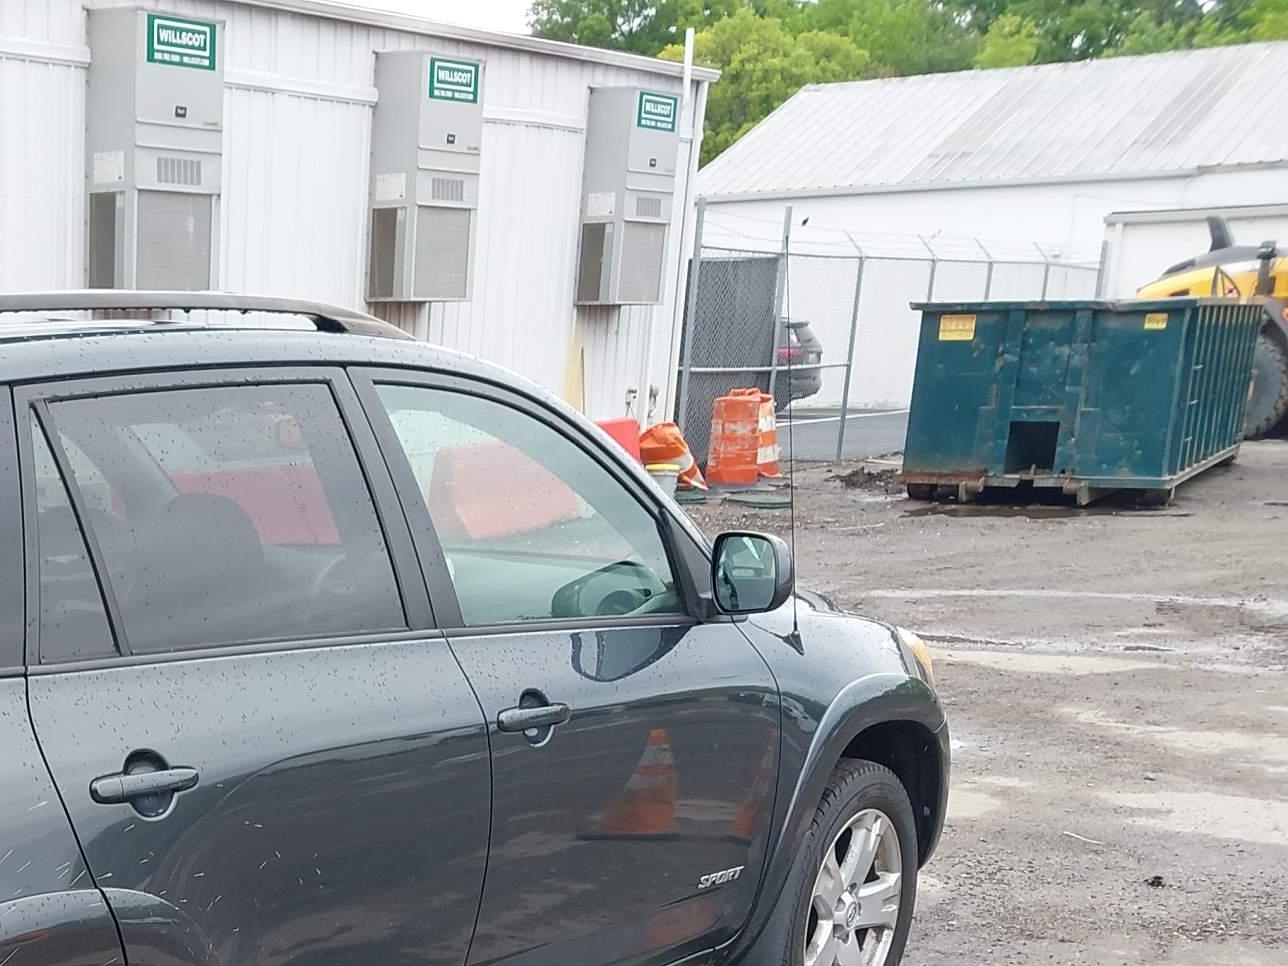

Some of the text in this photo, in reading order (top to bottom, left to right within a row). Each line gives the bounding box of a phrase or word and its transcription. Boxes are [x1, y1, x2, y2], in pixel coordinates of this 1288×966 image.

[159, 28, 206, 48] WILLSCOT
[438, 69, 472, 85] WILLSCOT
[698, 865, 744, 888] SPORT
